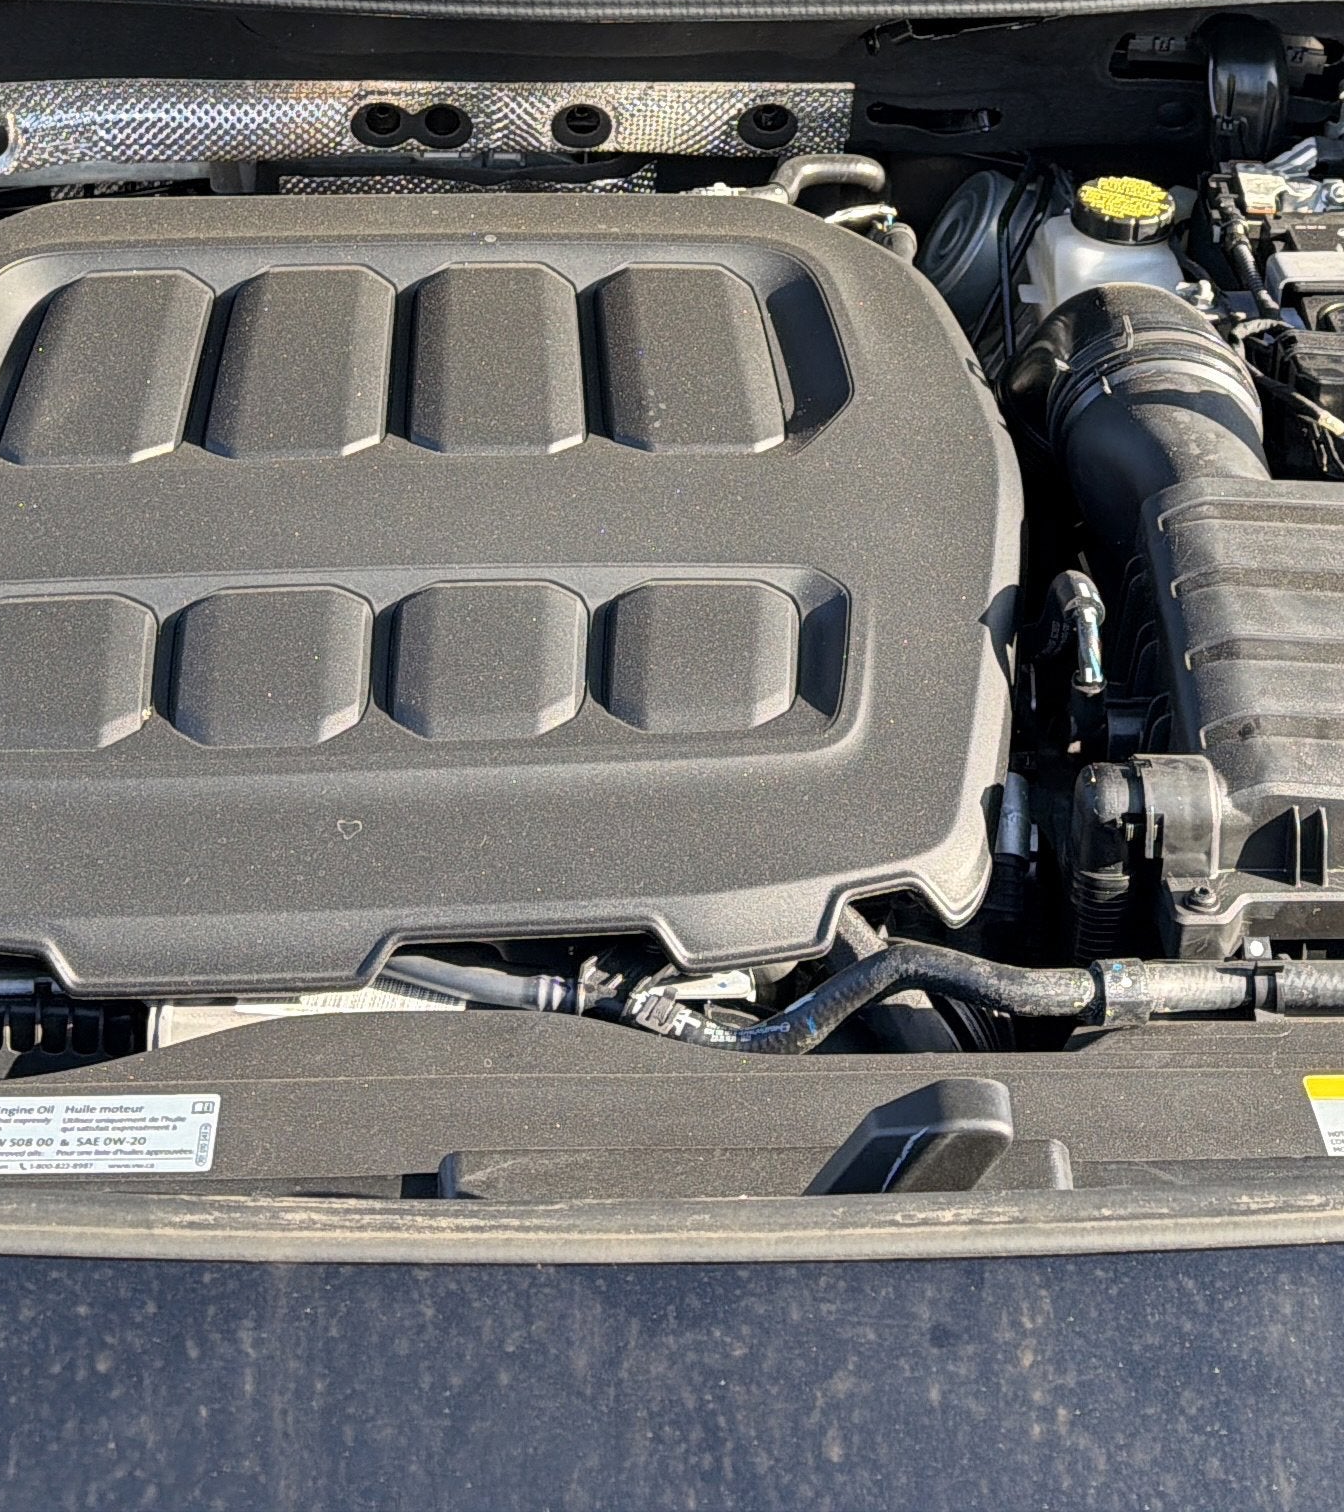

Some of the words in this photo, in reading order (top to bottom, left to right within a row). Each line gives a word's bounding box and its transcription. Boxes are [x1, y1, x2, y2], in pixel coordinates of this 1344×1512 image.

[36, 1105, 55, 1114] Oil
[64, 1105, 96, 1114] Huile
[99, 1106, 144, 1114] moteur
[9, 1138, 33, 1147] 508
[36, 1138, 54, 1147] 00
[76, 1137, 100, 1146] SAE
[103, 1137, 147, 1146] 0W-20
